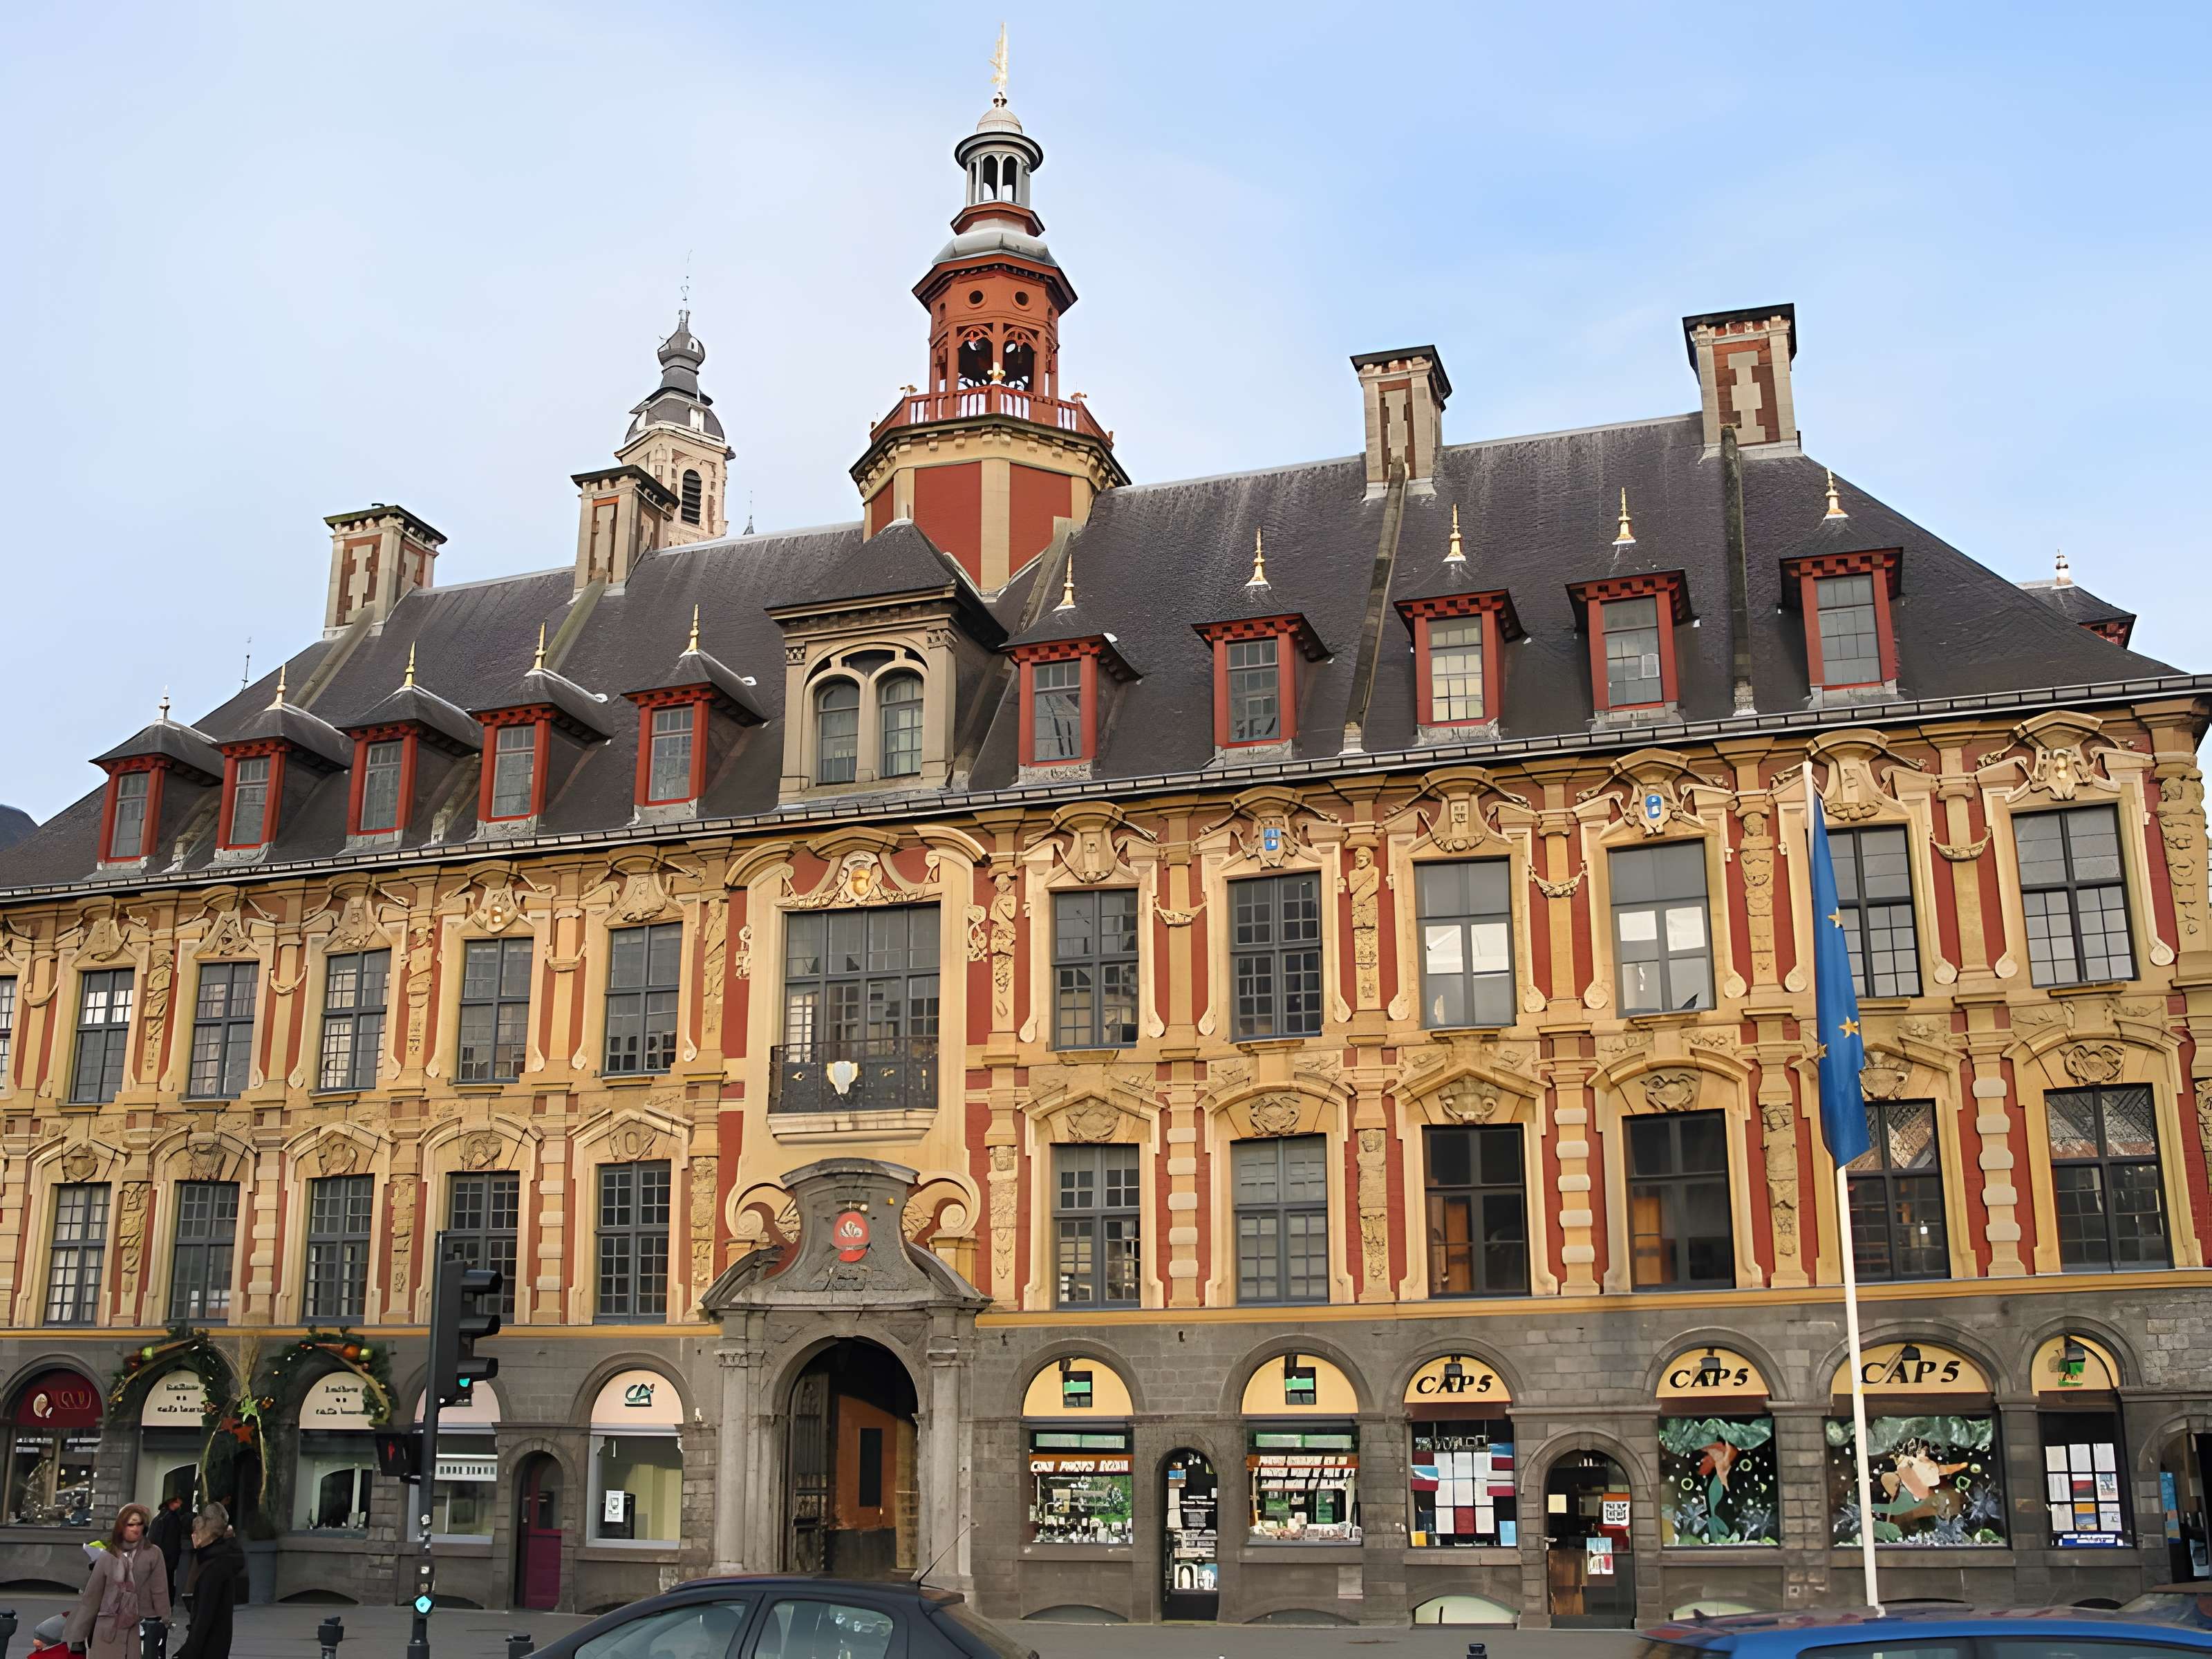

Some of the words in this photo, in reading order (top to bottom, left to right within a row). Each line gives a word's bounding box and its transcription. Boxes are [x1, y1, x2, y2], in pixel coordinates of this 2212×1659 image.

[1669, 1369, 1731, 1388] CAP
[1733, 1368, 1749, 1387] 5
[1861, 1361, 1937, 1384] CAP
[1940, 1360, 1961, 1383] 5
[1416, 1375, 1474, 1394] CAP
[1477, 1375, 1493, 1393] 5
